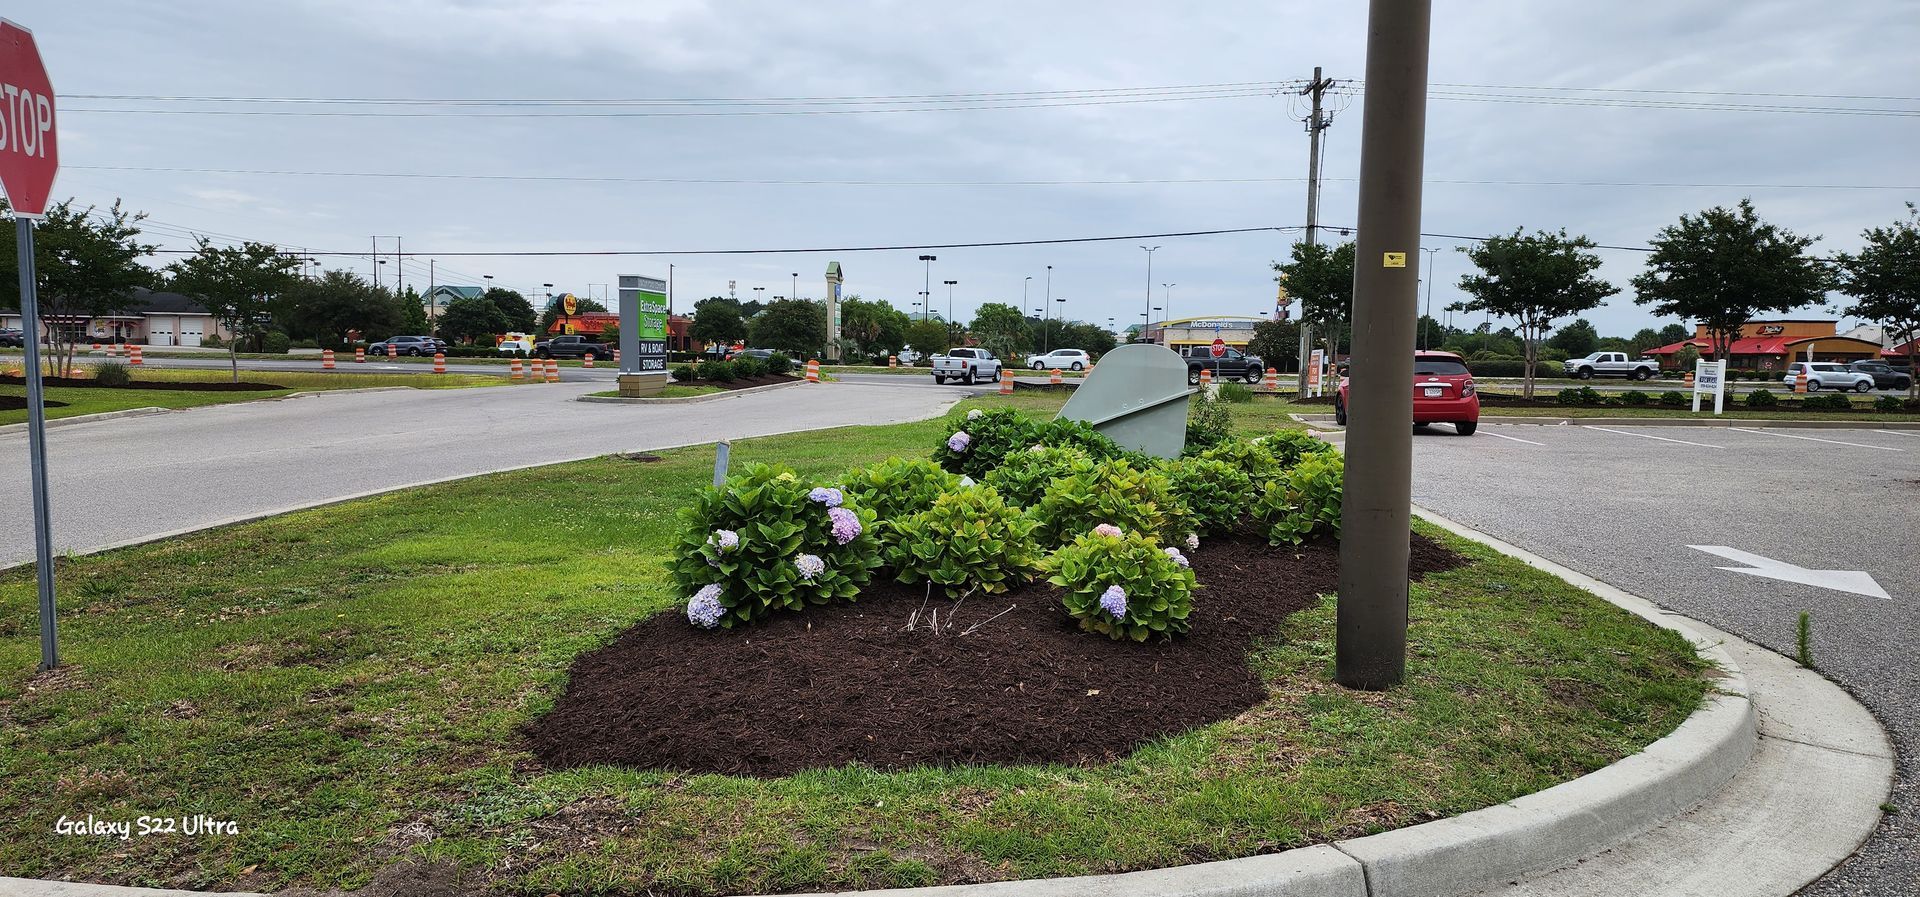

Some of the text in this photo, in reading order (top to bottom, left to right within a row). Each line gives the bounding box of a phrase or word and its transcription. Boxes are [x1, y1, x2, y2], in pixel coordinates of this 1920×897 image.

[640, 300, 666, 314] ExtraSpace
[643, 315, 662, 331] Storage
[641, 343, 664, 354] RV & BOAT
[642, 359, 664, 370] STORAGE
